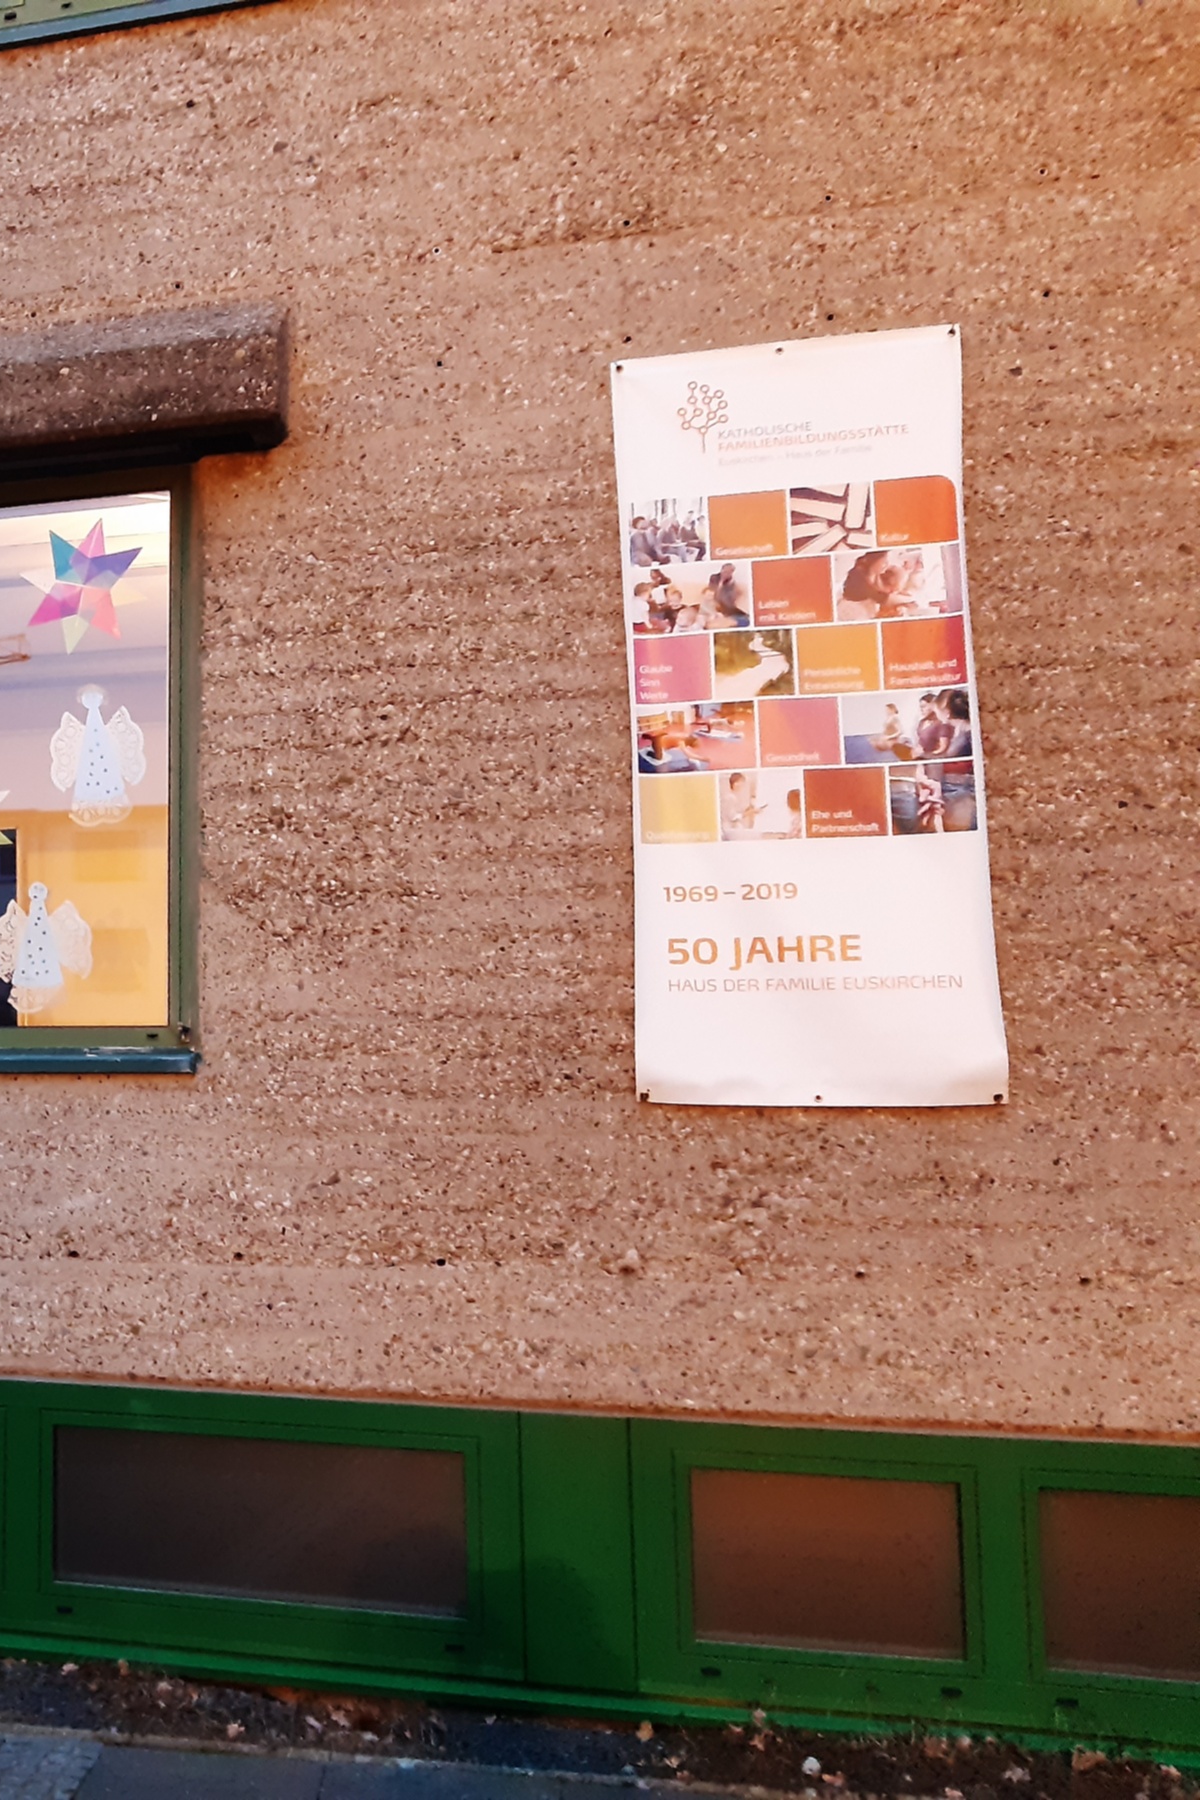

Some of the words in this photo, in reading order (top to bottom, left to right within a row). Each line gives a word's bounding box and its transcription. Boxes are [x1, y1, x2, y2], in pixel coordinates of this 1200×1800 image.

[718, 421, 812, 439] KATHOLISCHE
[718, 424, 910, 452] FAMILIENBILDUNGSSTÄTTE
[759, 600, 790, 610] Leben
[759, 613, 776, 622] mit
[778, 611, 816, 621] Kindern
[639, 664, 673, 674] Glaube
[889, 660, 934, 672] Haushalt
[937, 658, 957, 669] und
[639, 678, 660, 687] Sinn
[889, 673, 962, 685] Familienkultur
[640, 691, 669, 700] Werte
[766, 752, 820, 763] Gesundheit
[811, 810, 831, 819] Ehe
[833, 809, 852, 819] und
[811, 823, 879, 833] Partnerschaft
[667, 937, 718, 965] 50
[729, 934, 862, 971] JAHRE
[668, 978, 717, 992] HAUS
[723, 978, 759, 991] DER
[766, 976, 836, 991] FAMILIE
[843, 975, 963, 991] EUSKIRCHEN
